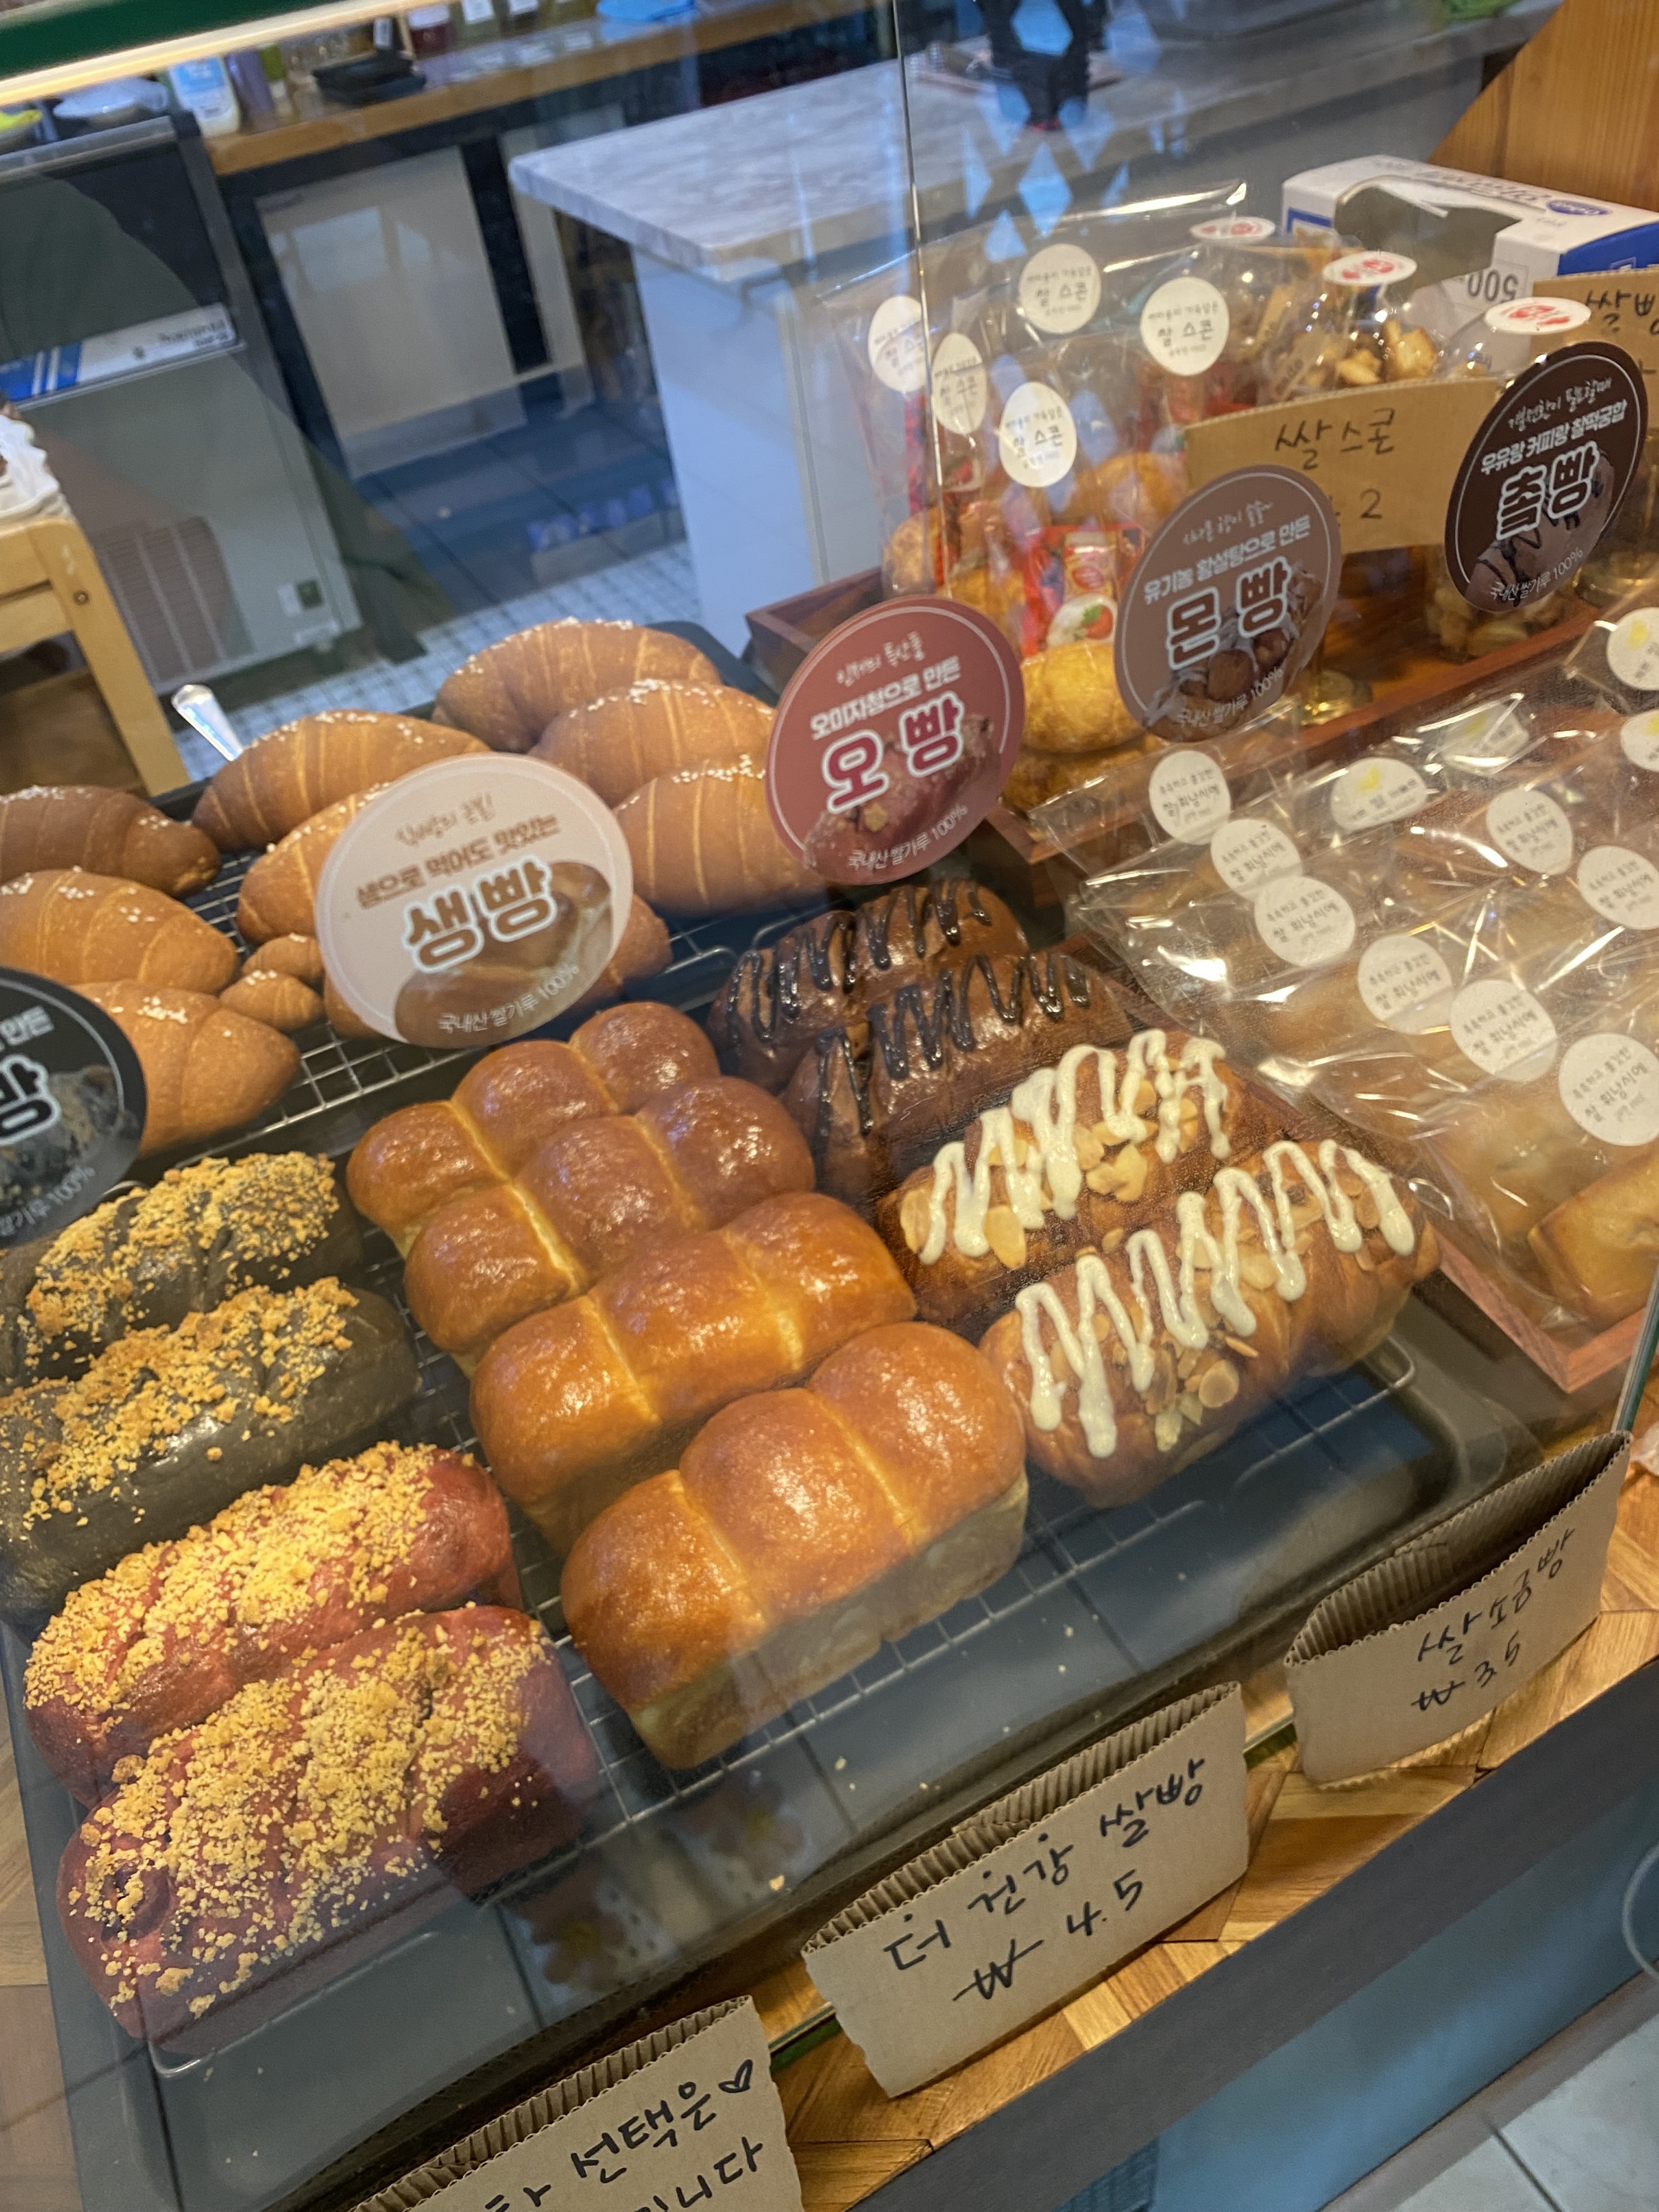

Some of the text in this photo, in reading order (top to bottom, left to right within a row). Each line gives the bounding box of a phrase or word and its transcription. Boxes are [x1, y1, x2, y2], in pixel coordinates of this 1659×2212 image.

[1183, 320, 1214, 341] 스콘
[1034, 425, 1063, 446] 스콘
[1274, 408, 1396, 471] 쌀 스콘
[1481, 398, 1628, 475] 우유랑 커피랑 찰떡궁합
[1144, 568, 1194, 605] 유기농
[1197, 530, 1277, 582] 황설탕으로
[1279, 515, 1311, 547] 만든
[1553, 547, 1583, 575] 100%
[810, 655, 961, 741] 오미자청으로 만든
[1250, 665, 1284, 701] 100%
[931, 804, 969, 841] 100%
[357, 814, 561, 910] 생으로 먹어도 맛있는
[402, 854, 557, 974] 생빵
[1290, 900, 1340, 930] 휘낭시에
[438, 964, 579, 1035] 국내산 쌀가루 100%
[1599, 1062, 1648, 1106] 휘낭시에
[883, 1920, 951, 1971] 더
[1099, 1758, 1205, 1848] 쌀빵
[571, 2081, 716, 2184] 선택은
